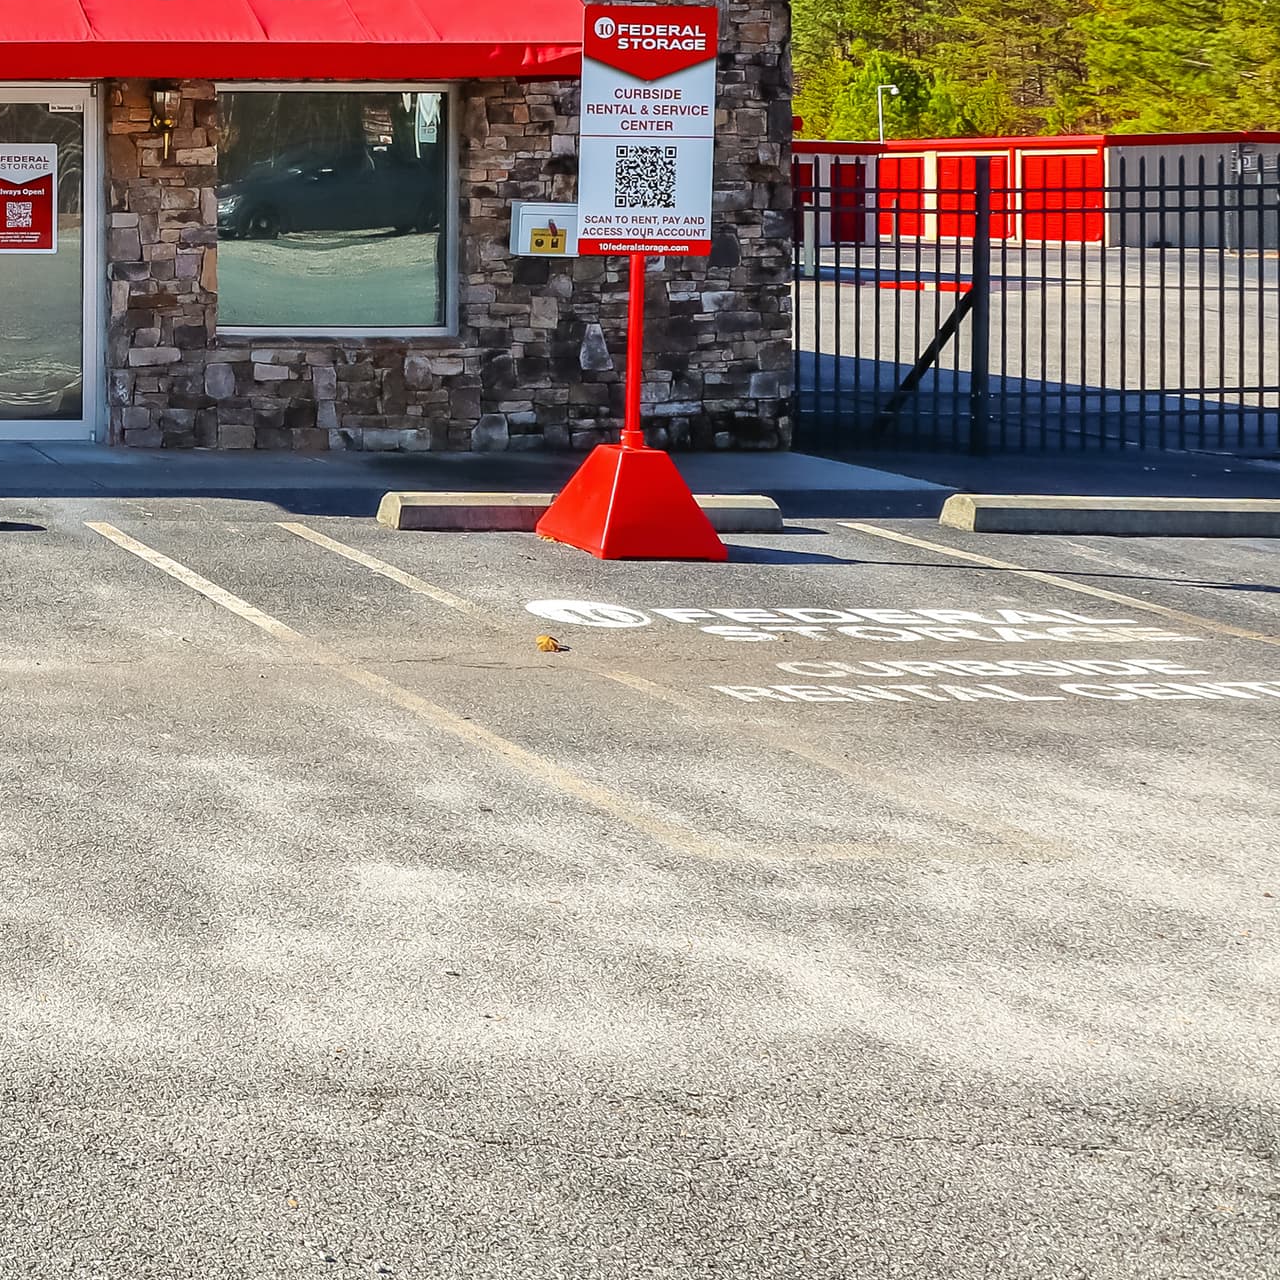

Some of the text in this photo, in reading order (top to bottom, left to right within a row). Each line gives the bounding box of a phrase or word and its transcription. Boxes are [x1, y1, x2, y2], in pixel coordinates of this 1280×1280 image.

[599, 23, 706, 37] 10 FEDERAL
[617, 37, 706, 51] STORAGE
[614, 88, 682, 100] CURBSIDE
[586, 104, 709, 116] RENTAL & SERVICE
[620, 120, 674, 131] CENTER
[0, 155, 50, 163] FEDERAL
[22, 187, 45, 196] Open!
[584, 215, 612, 224] SCAN
[615, 216, 629, 224] TO
[631, 216, 660, 226] RENT,
[683, 217, 705, 225] AND
[582, 227, 706, 237] ACCESS YOUR ACCOUNT
[598, 242, 689, 253] 10federalstorage.com
[649, 608, 1139, 624] FEDERAL
[700, 625, 1205, 642] STORAGE
[776, 659, 1211, 677] CURBSIDE
[708, 684, 1067, 702] RENTAL
